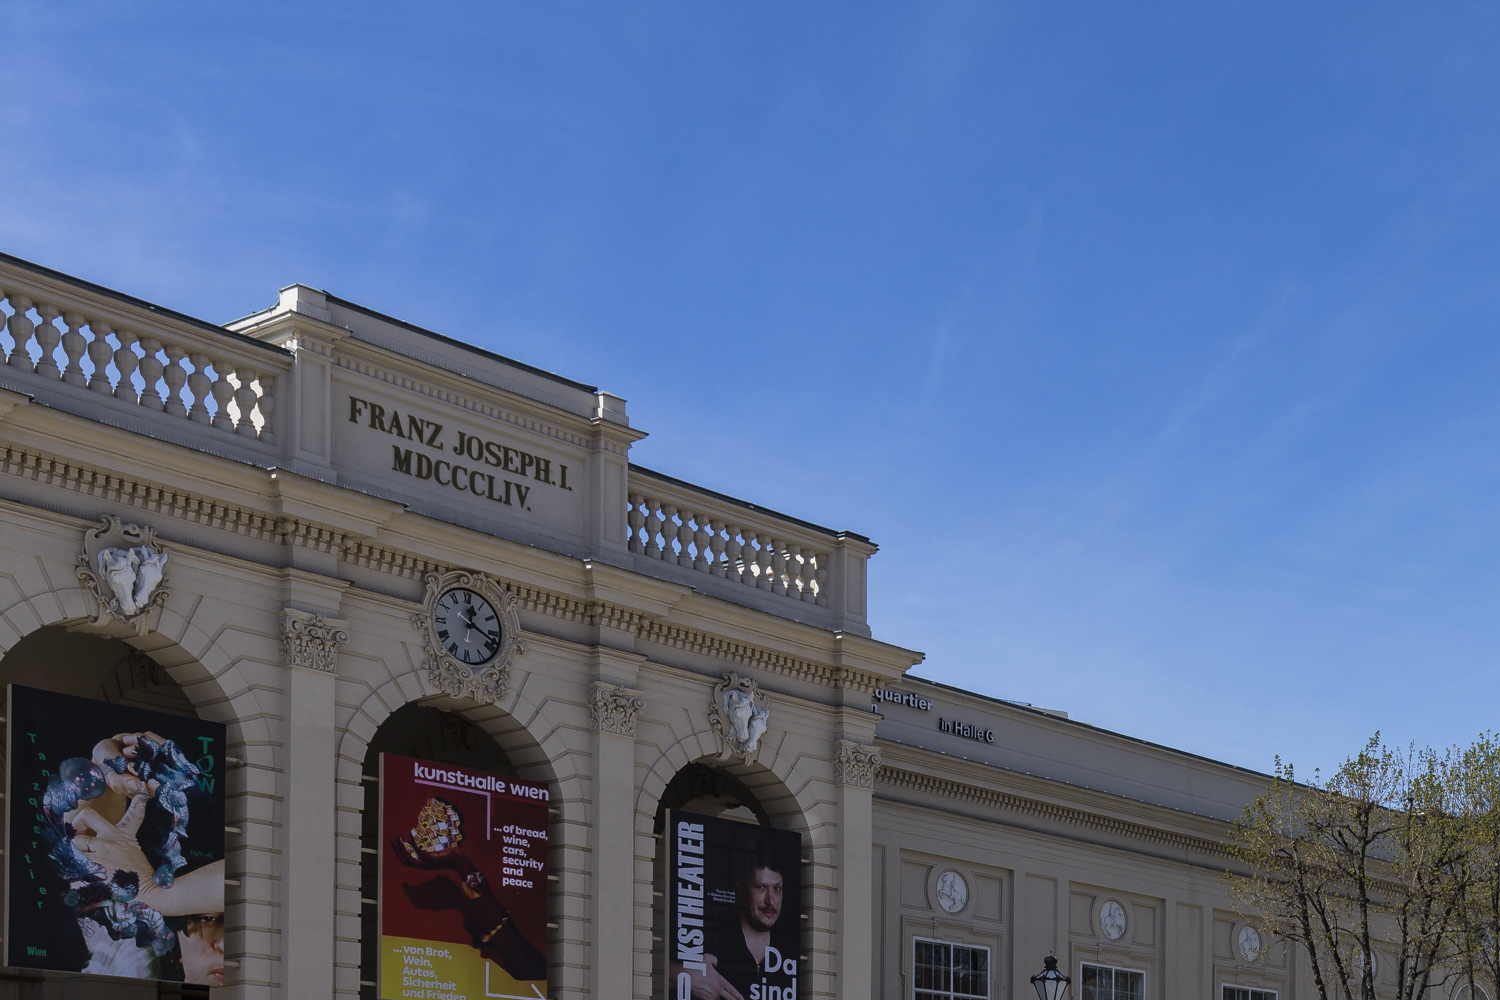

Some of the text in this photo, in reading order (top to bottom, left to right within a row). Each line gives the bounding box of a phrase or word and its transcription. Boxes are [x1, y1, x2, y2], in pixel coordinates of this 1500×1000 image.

[349, 396, 444, 451] FRANZ
[392, 445, 531, 512] MDCCCLIV.
[872, 688, 933, 711] quartier
[941, 718, 994, 742] in Halle G
[196, 735, 215, 794] TQW
[515, 825, 549, 841] bread,
[502, 835, 531, 848] wine,
[502, 846, 527, 858] cars,
[502, 855, 544, 872] security
[502, 866, 524, 877] and
[502, 877, 533, 889] peace
[26, 946, 47, 957] Wien
[425, 947, 452, 960] Brot,
[403, 955, 433, 968] Wein,
[764, 946, 797, 976] Da
[402, 966, 438, 979] Autos,
[402, 976, 457, 991] Sicherheit
[402, 988, 424, 998] und
